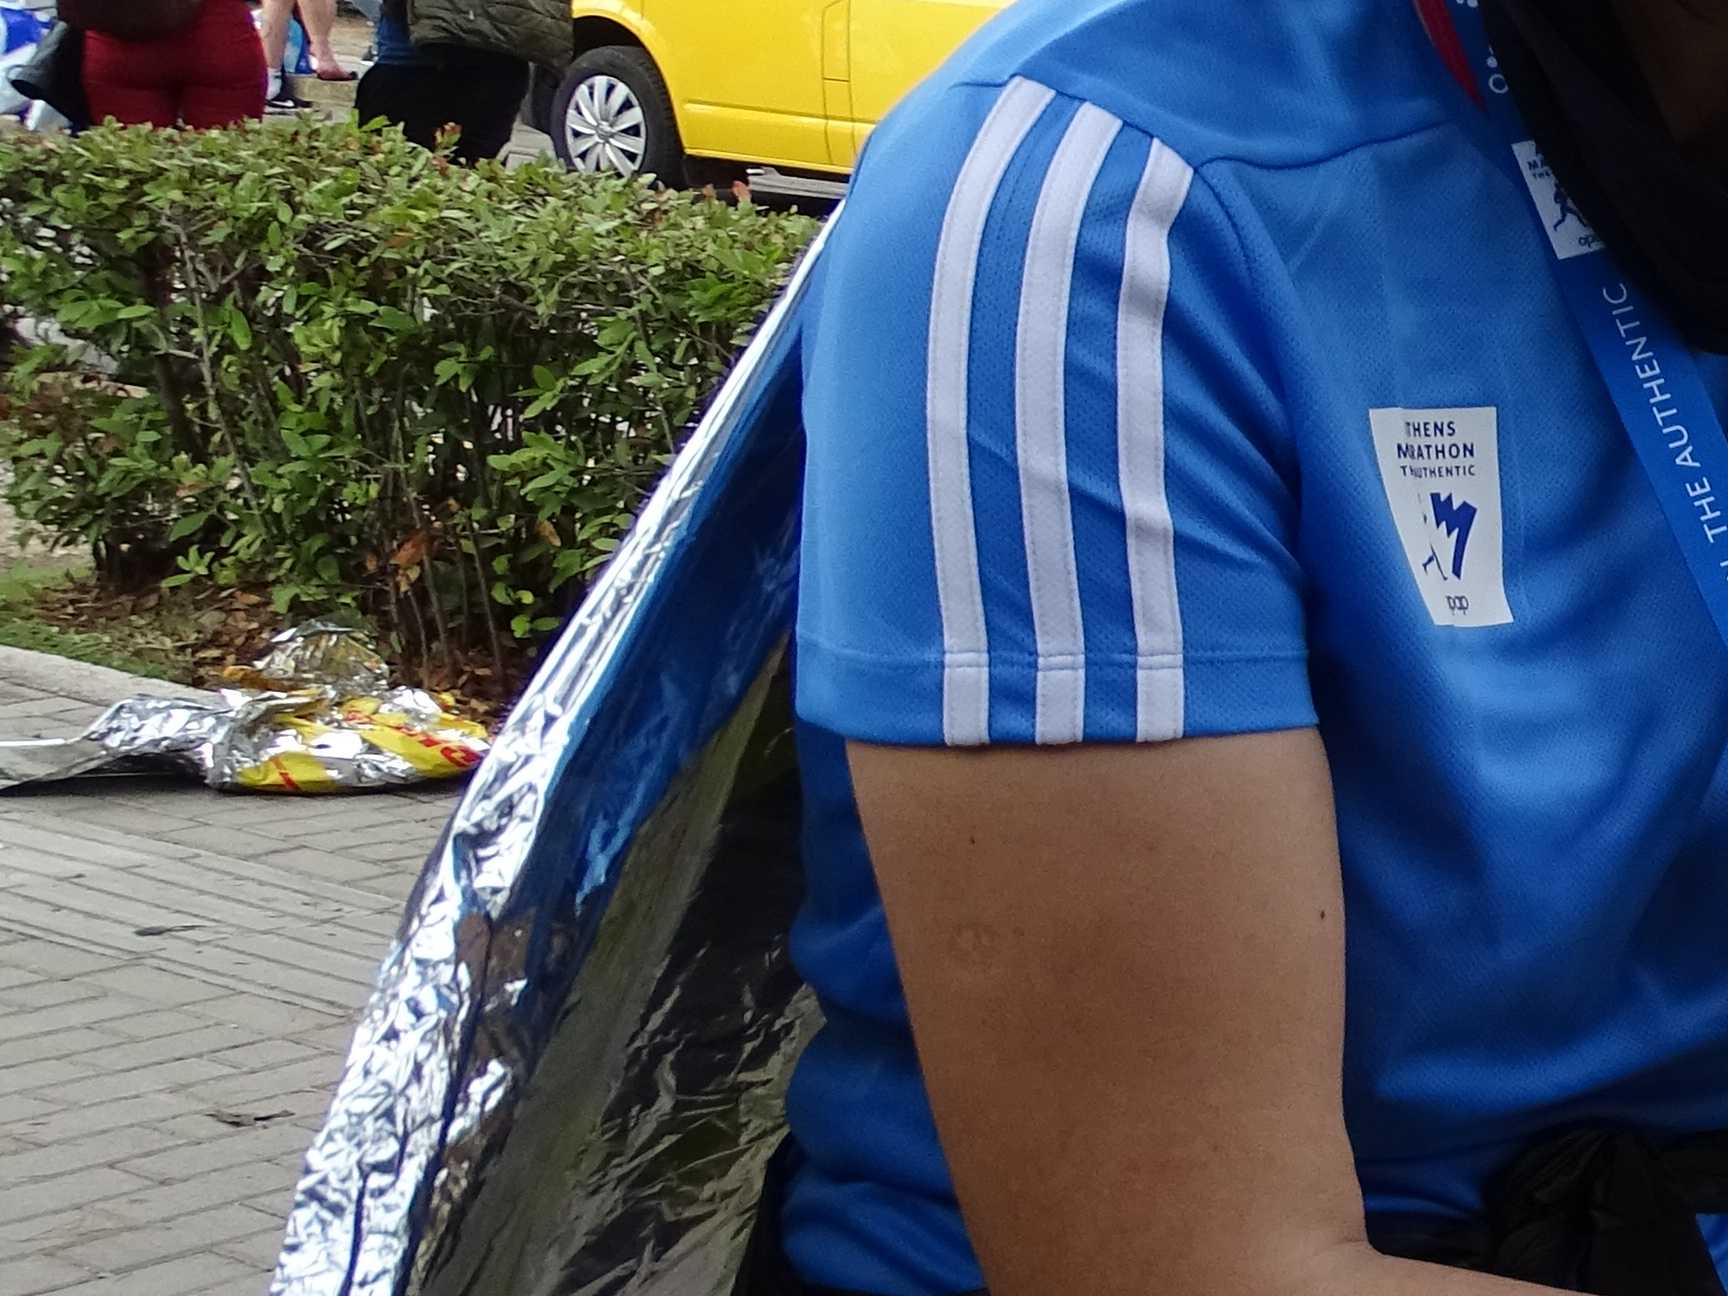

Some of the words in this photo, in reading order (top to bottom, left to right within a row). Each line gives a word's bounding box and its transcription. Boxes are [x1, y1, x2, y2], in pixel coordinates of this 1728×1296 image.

[1602, 283, 1701, 467] AUTHENTIC
[1406, 421, 1456, 437] THENS
[1685, 477, 1728, 543] THE
